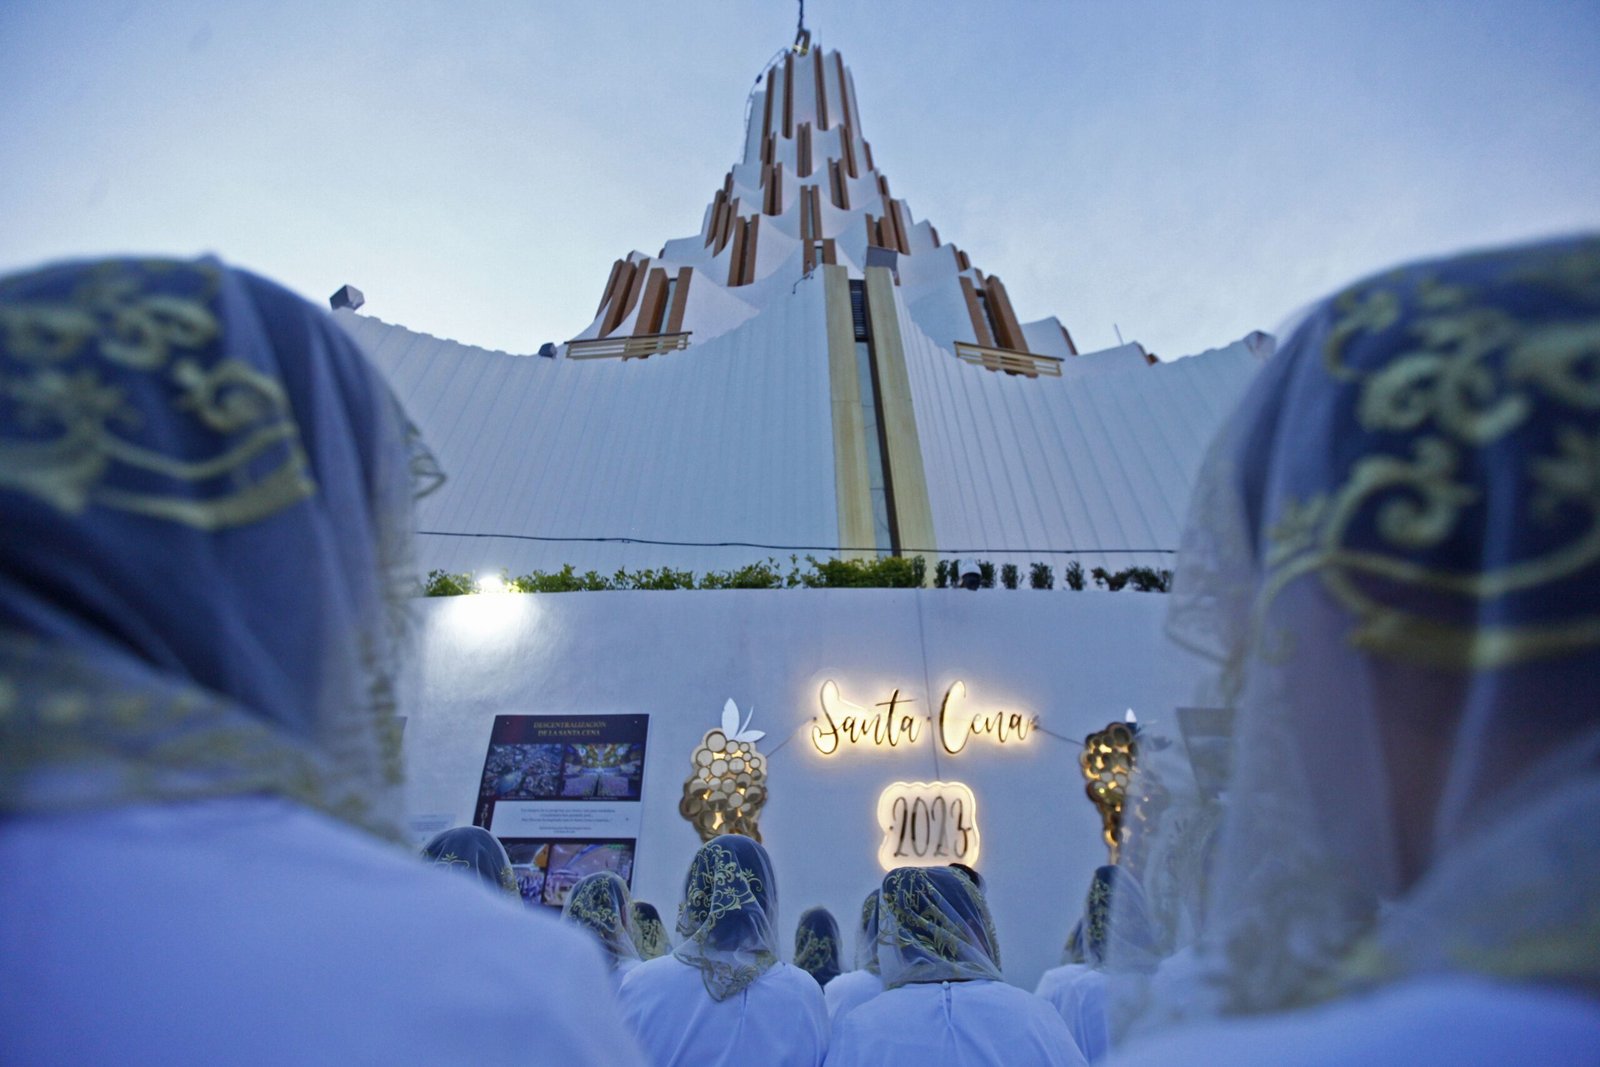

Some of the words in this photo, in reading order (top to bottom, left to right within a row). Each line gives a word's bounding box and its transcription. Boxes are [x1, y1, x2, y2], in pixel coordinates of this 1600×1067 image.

[559, 729, 581, 737] SANTA
[812, 679, 922, 755] Santa
[939, 679, 1031, 755] Cena
[892, 795, 970, 859] 2023
